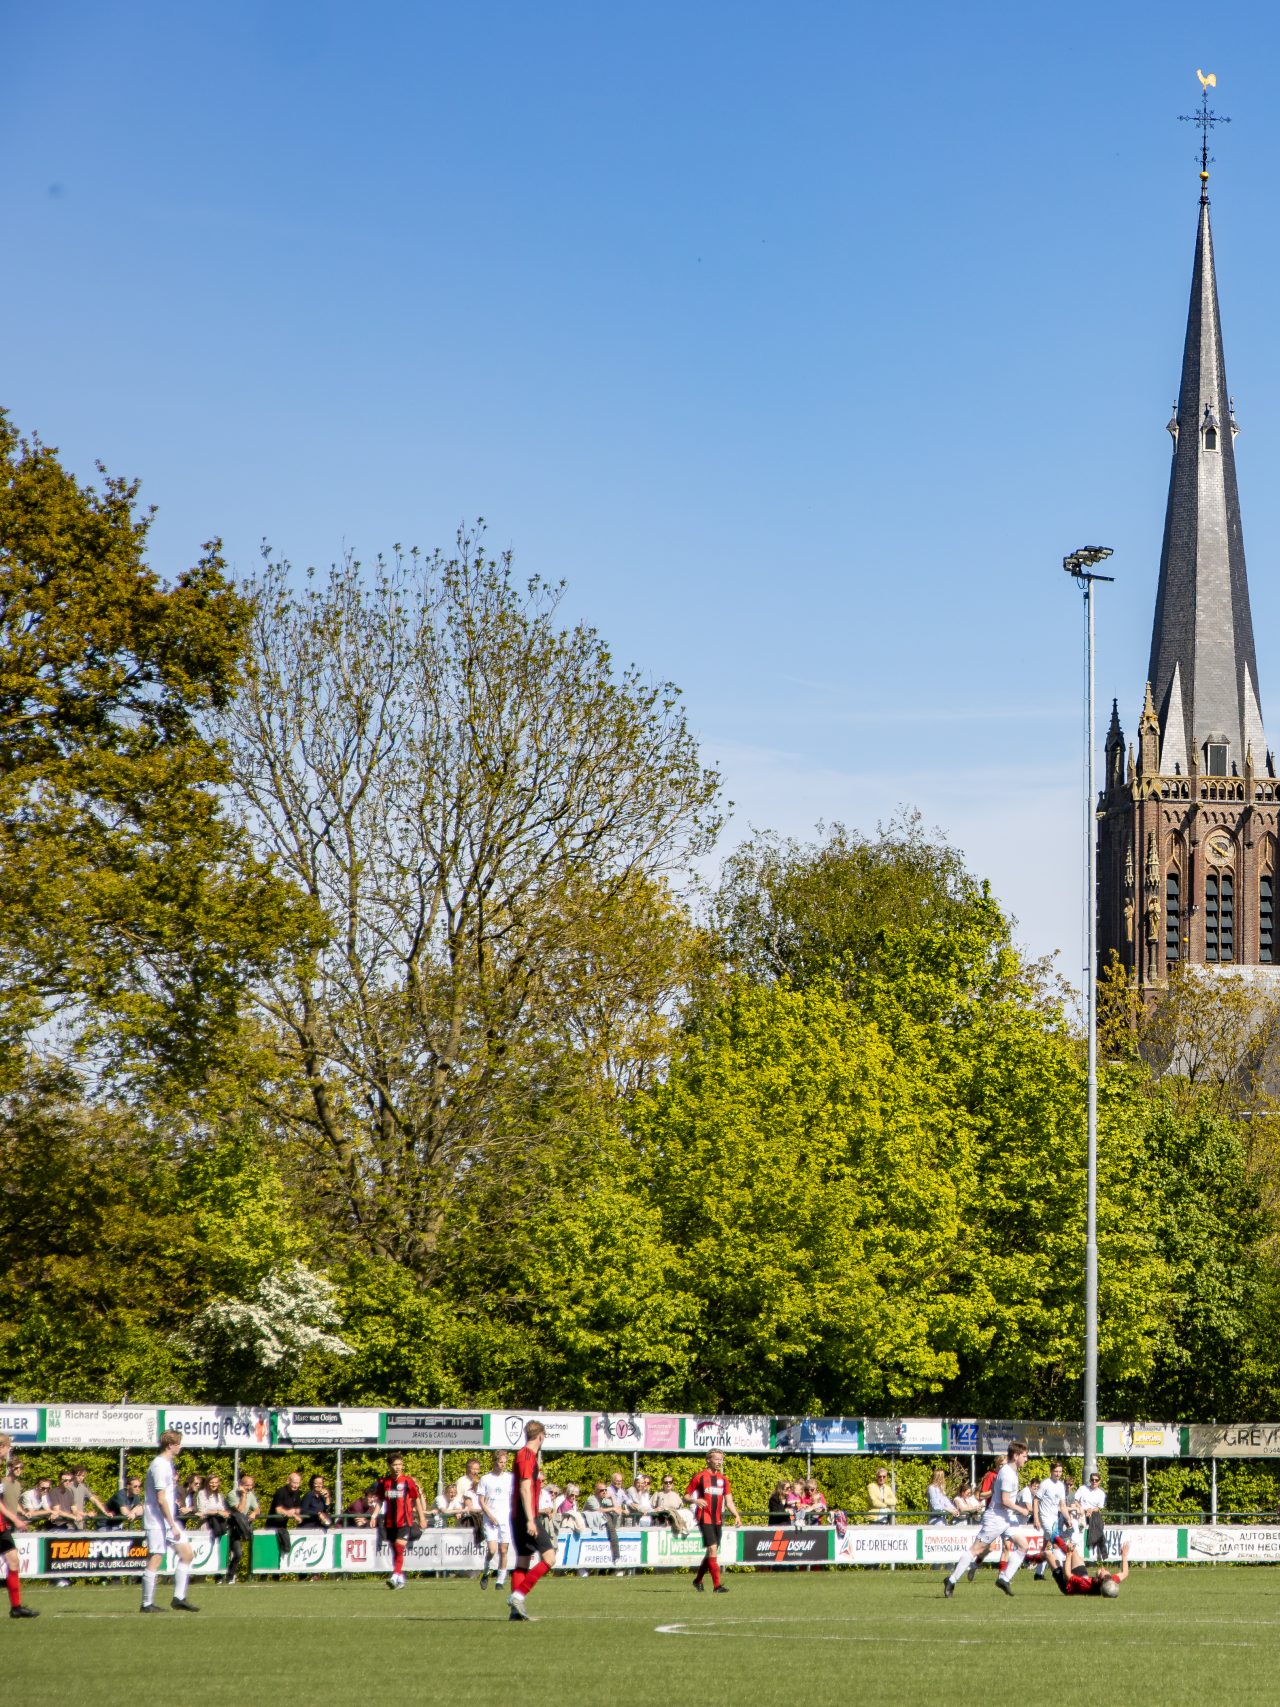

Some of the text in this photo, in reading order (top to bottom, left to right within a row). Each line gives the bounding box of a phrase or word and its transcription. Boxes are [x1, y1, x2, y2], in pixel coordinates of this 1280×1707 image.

[65, 1410, 143, 1422] Richard Spexgoor
[168, 1417, 219, 1440] seesing
[223, 1417, 250, 1435] flex
[671, 1539, 704, 1553] WESSEL
[788, 1541, 815, 1551] DISPLAY
[1219, 1543, 1254, 1551] MARTIN
[51, 1560, 147, 1570] KAMPIOEN IN CLUBKLEDING
